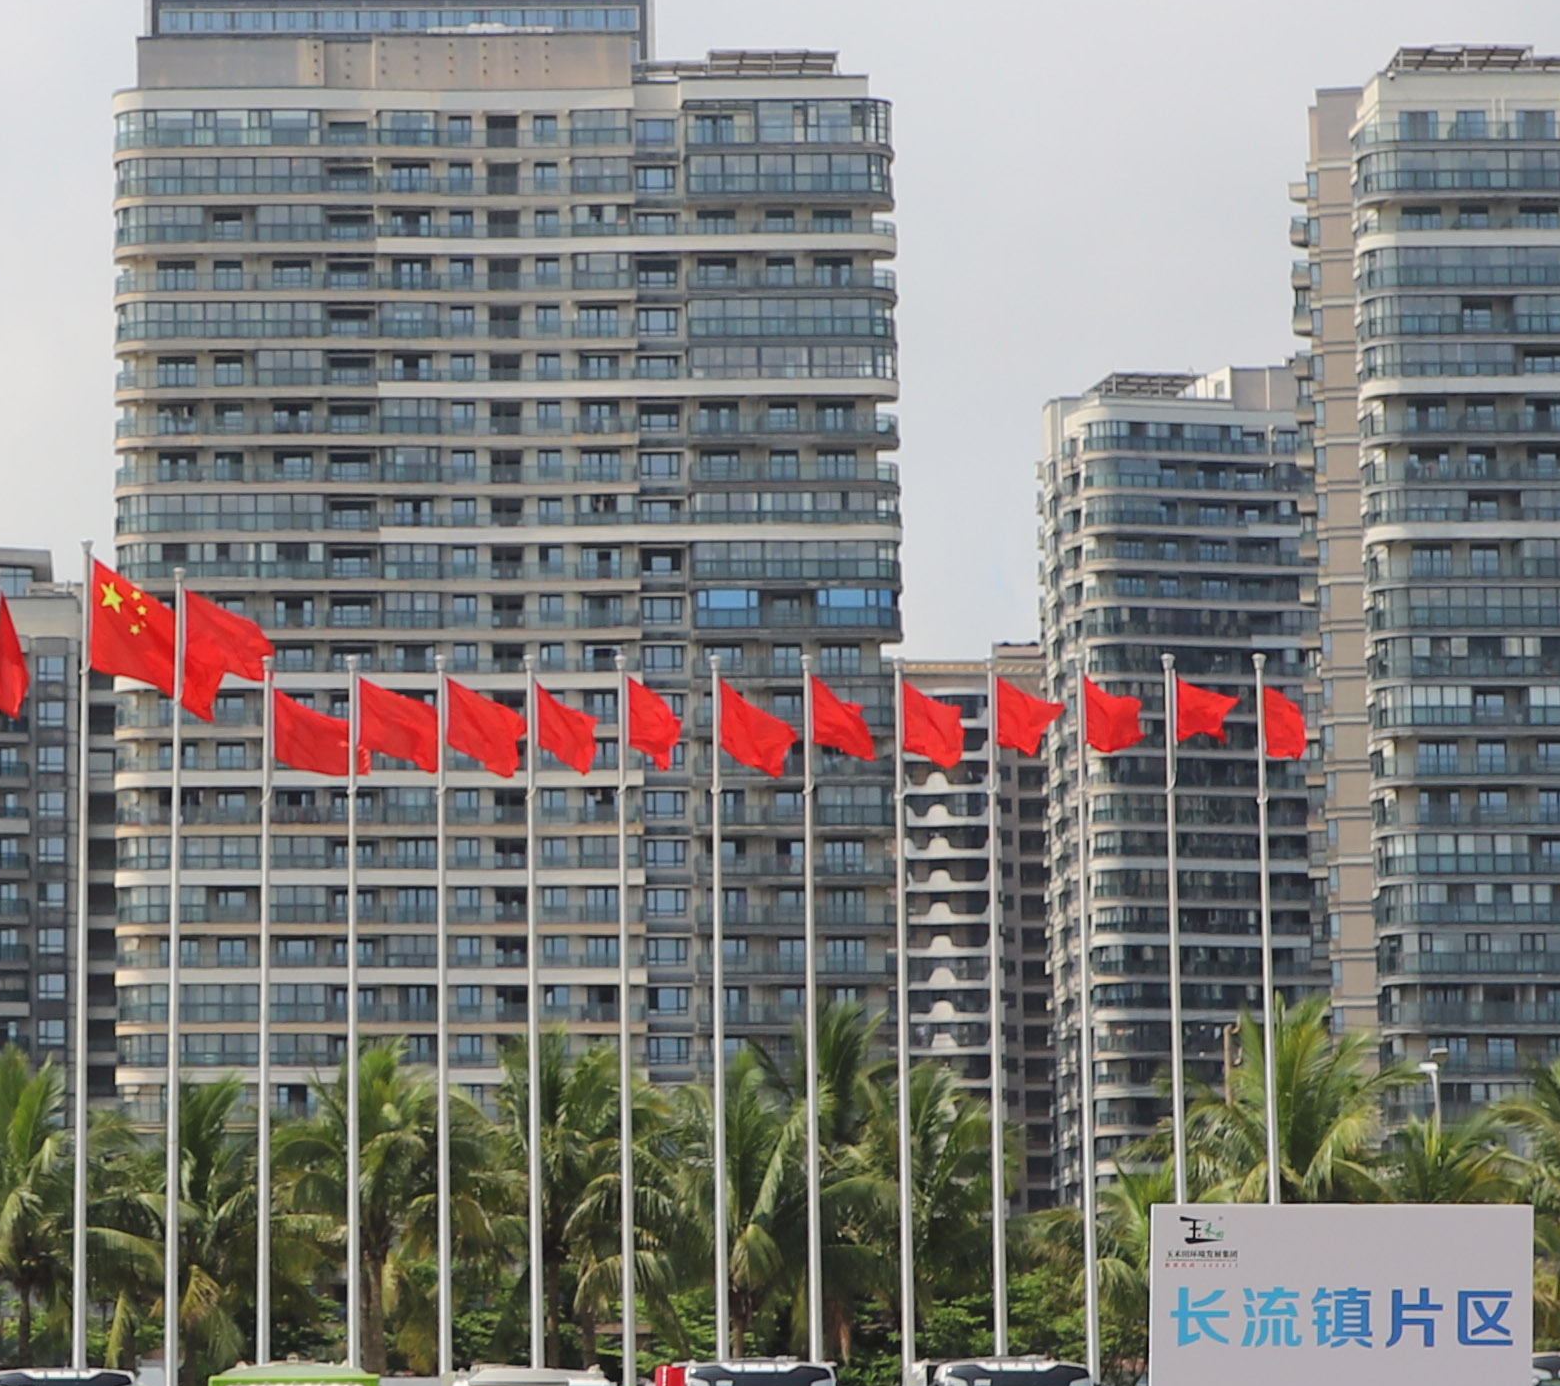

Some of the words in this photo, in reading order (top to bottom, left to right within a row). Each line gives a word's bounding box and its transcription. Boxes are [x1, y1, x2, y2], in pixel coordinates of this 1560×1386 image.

[1170, 1286, 1514, 1349] 长流镇片区
